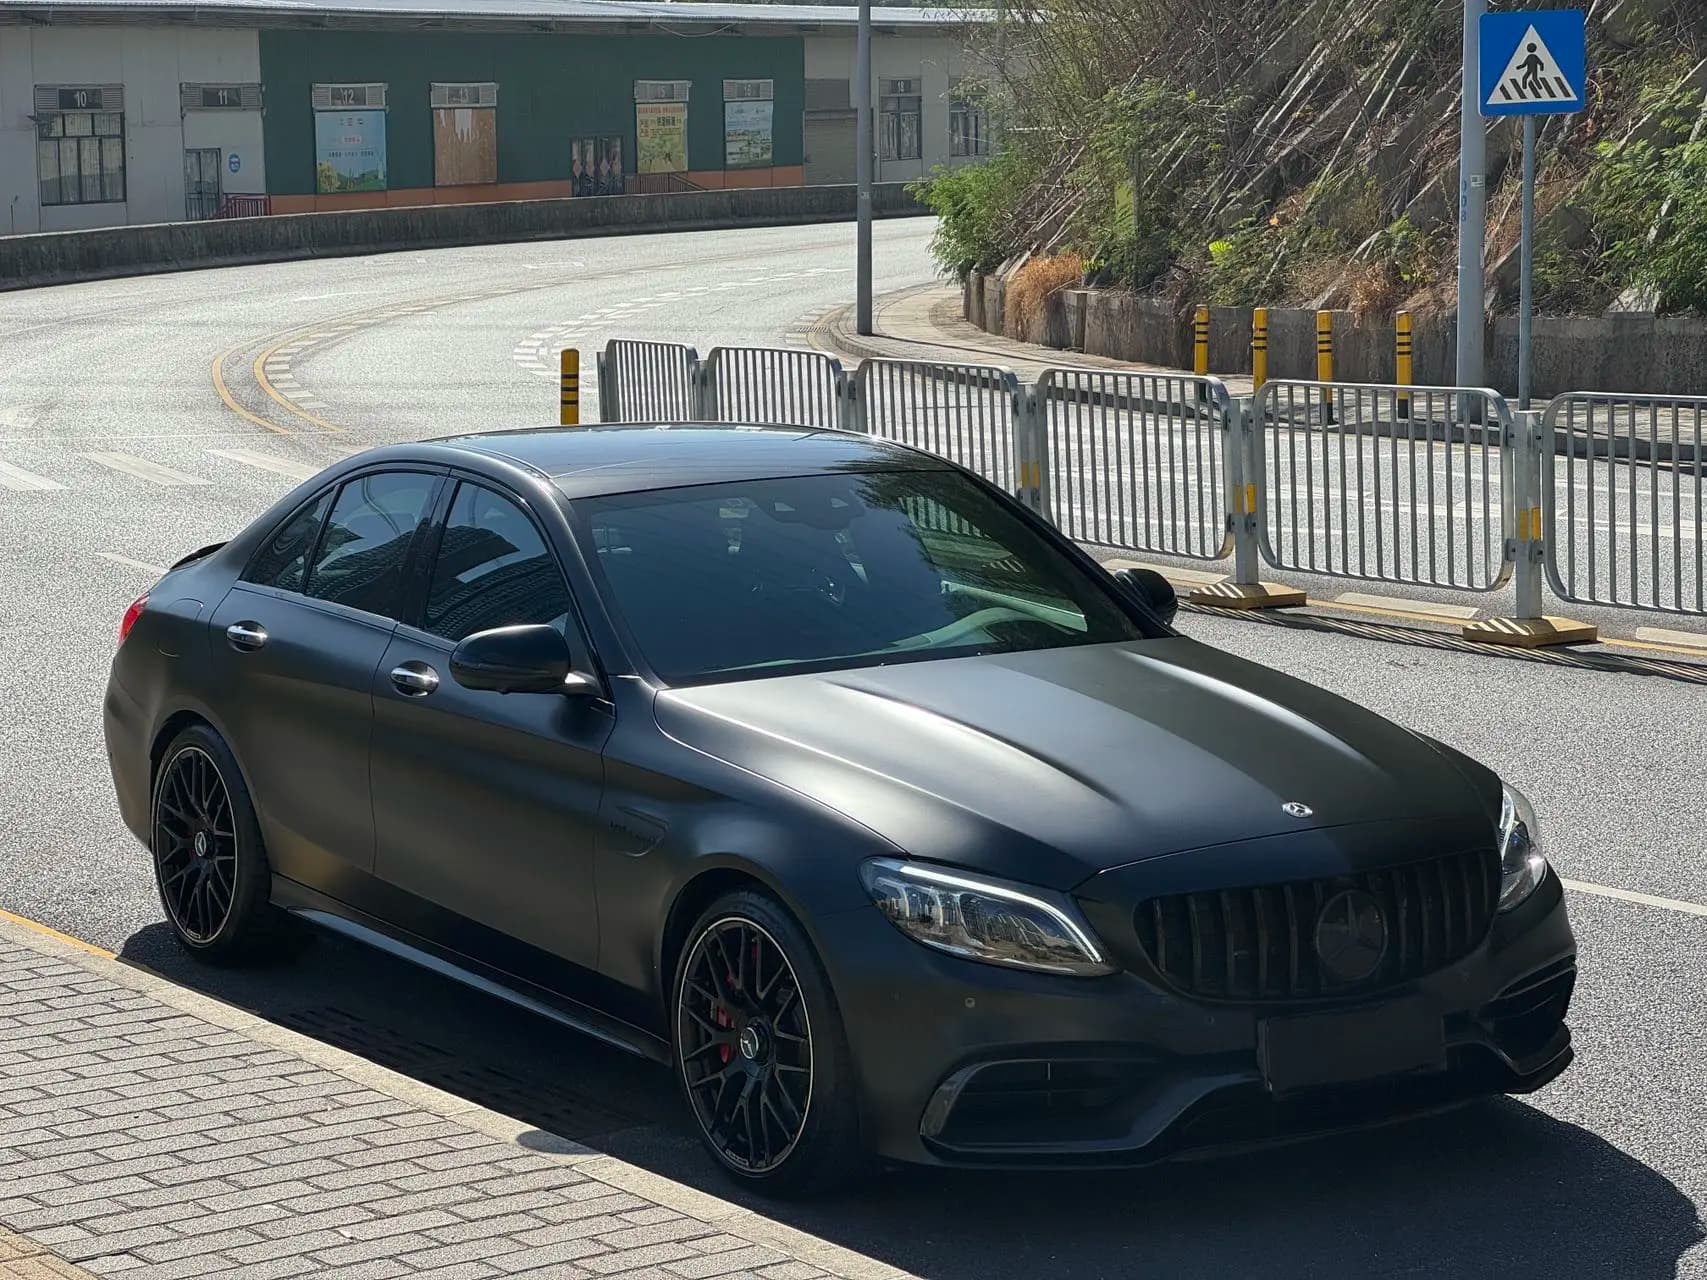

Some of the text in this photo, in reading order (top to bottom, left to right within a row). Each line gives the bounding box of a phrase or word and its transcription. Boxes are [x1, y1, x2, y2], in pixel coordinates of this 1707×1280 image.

[76, 90, 87, 107] 10
[218, 89, 228, 105] 11
[343, 89, 354, 104] 12
